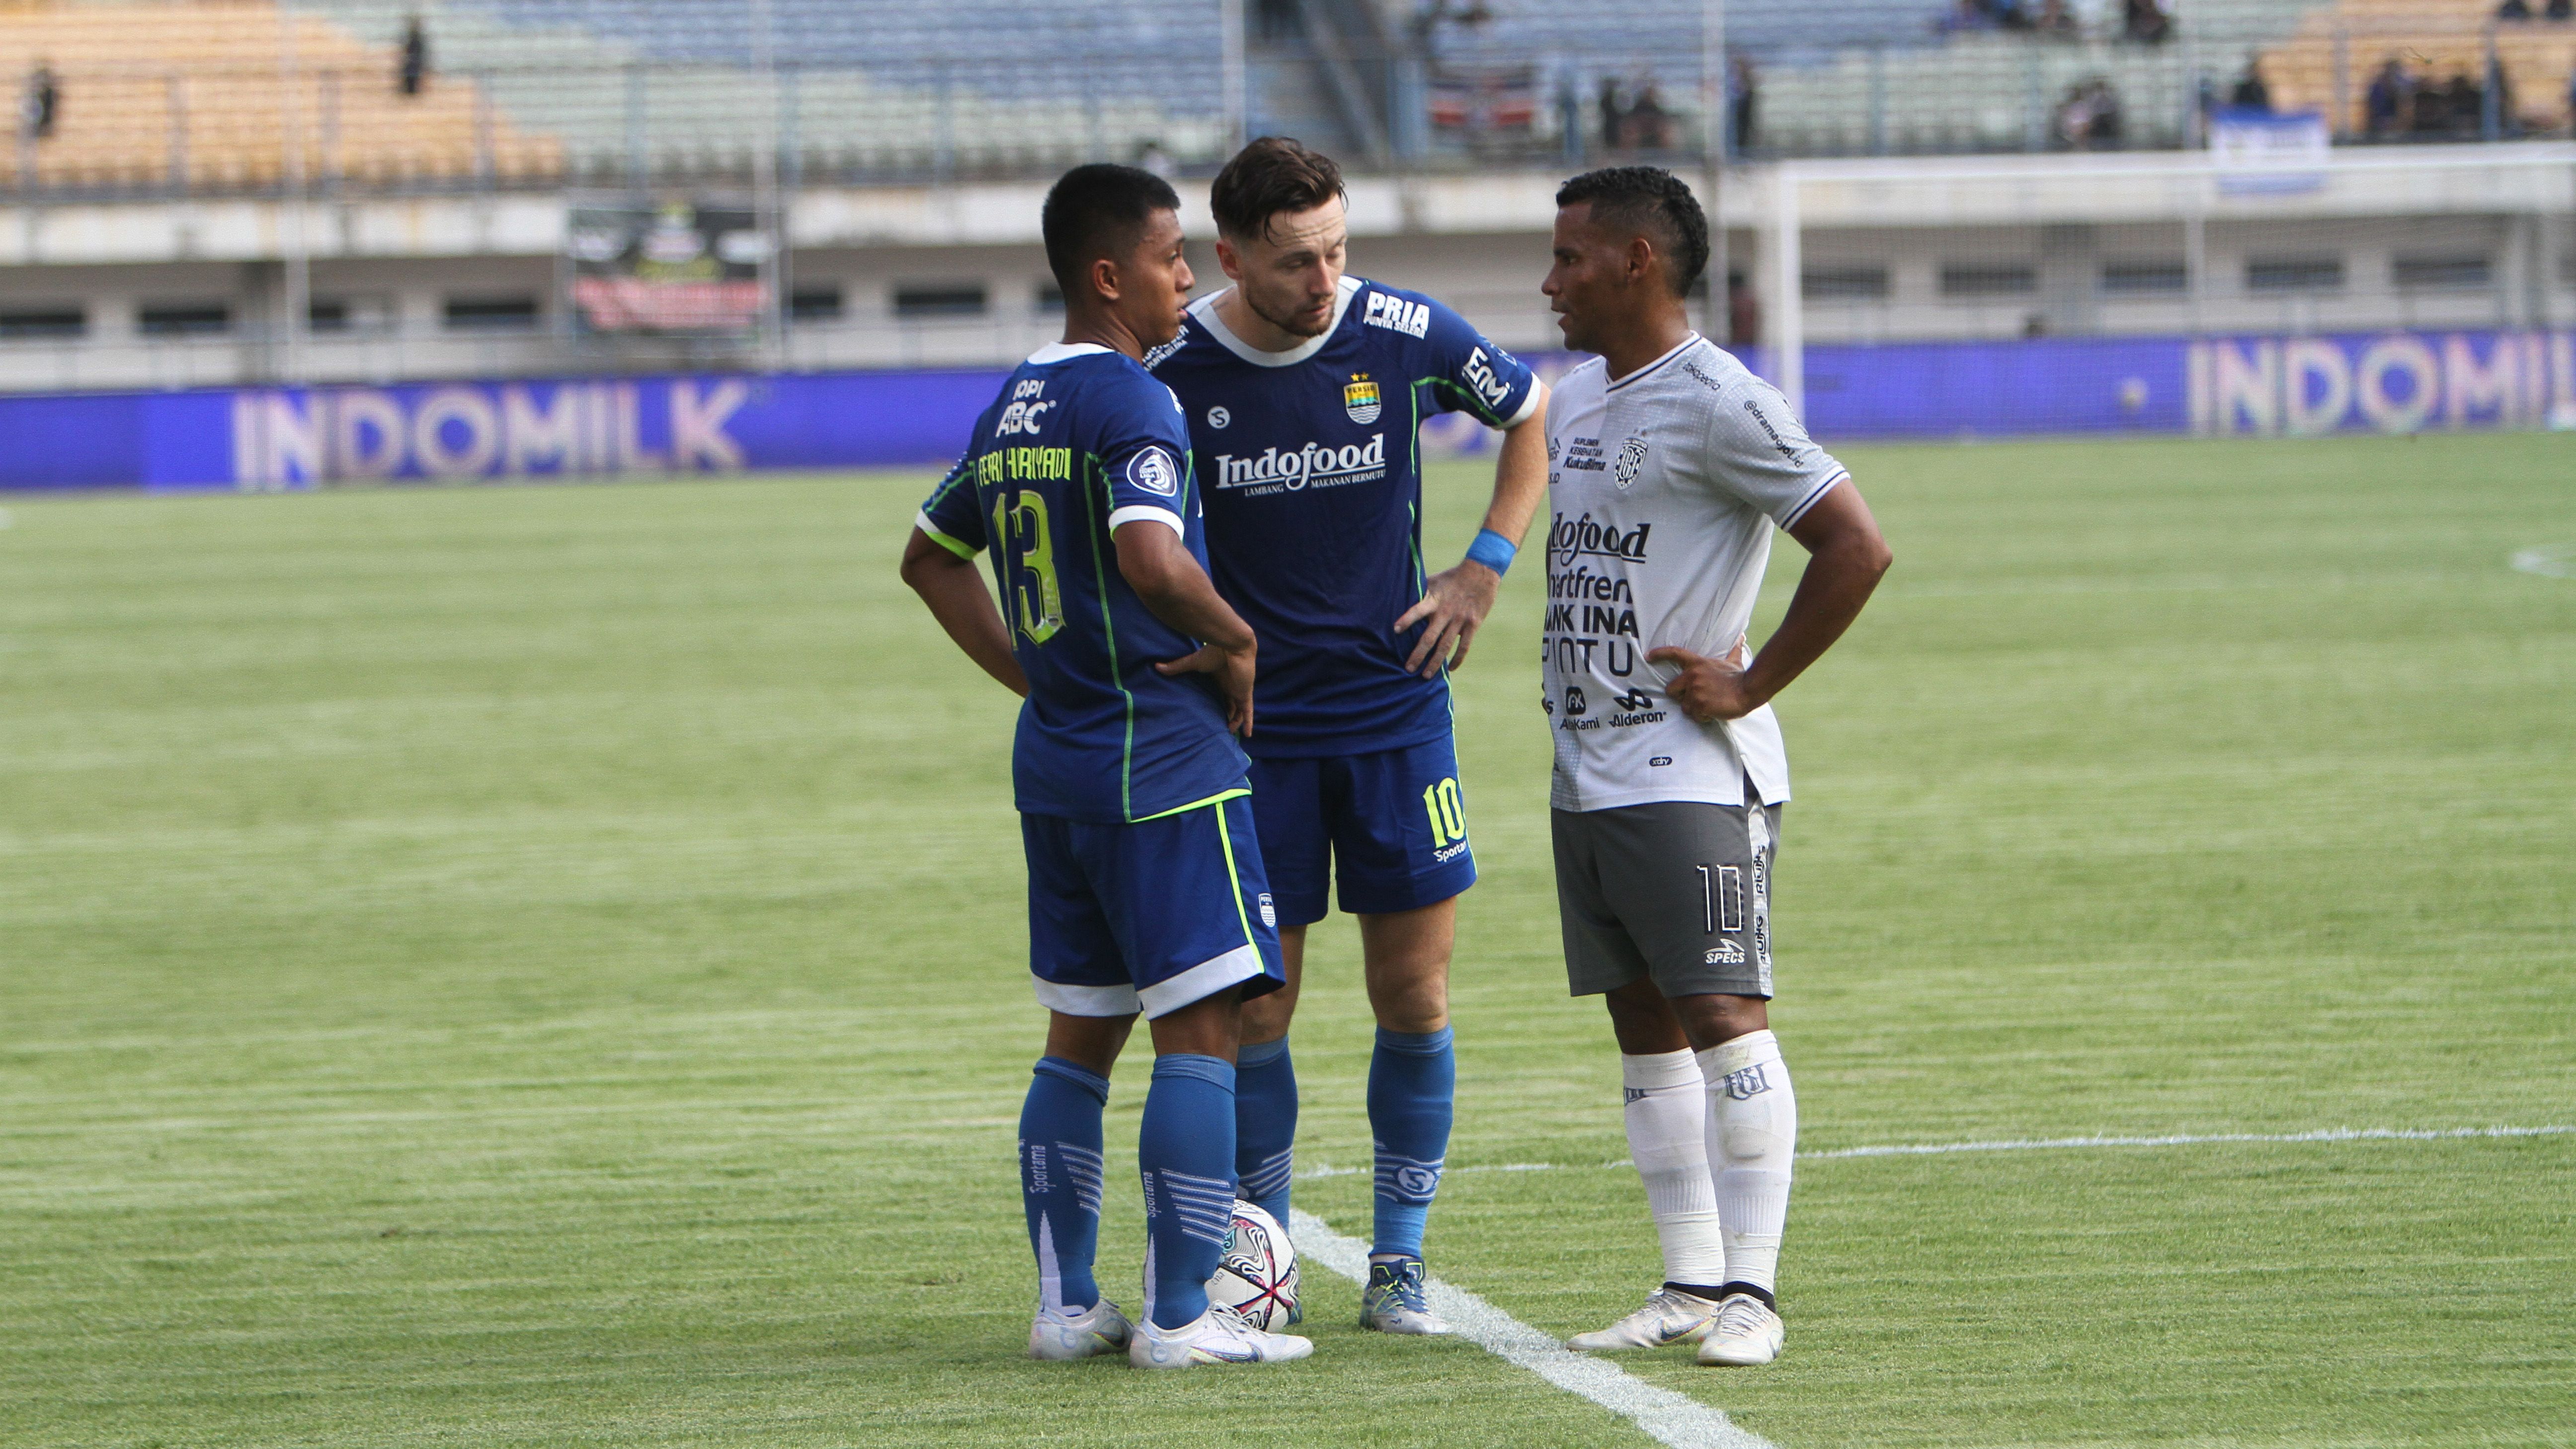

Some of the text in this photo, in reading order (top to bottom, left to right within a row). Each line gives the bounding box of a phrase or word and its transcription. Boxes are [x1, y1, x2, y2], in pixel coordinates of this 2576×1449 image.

[1363, 314, 1426, 340] PUNYA SELERA
[1364, 290, 1430, 331] PRIA
[234, 380, 746, 489] INDOMILK
[995, 401, 1048, 438] ABC
[1215, 432, 1385, 490] Indofood
[1245, 469, 1386, 497] LAMBANG MAKANAN BERMUTU
[1551, 511, 1651, 566] dofood
[993, 489, 1067, 650] 13
[1544, 604, 1575, 632] ANK
[1423, 777, 1465, 849] 10
[1696, 864, 1742, 932] 10
[1705, 952, 1745, 964] SPECS
